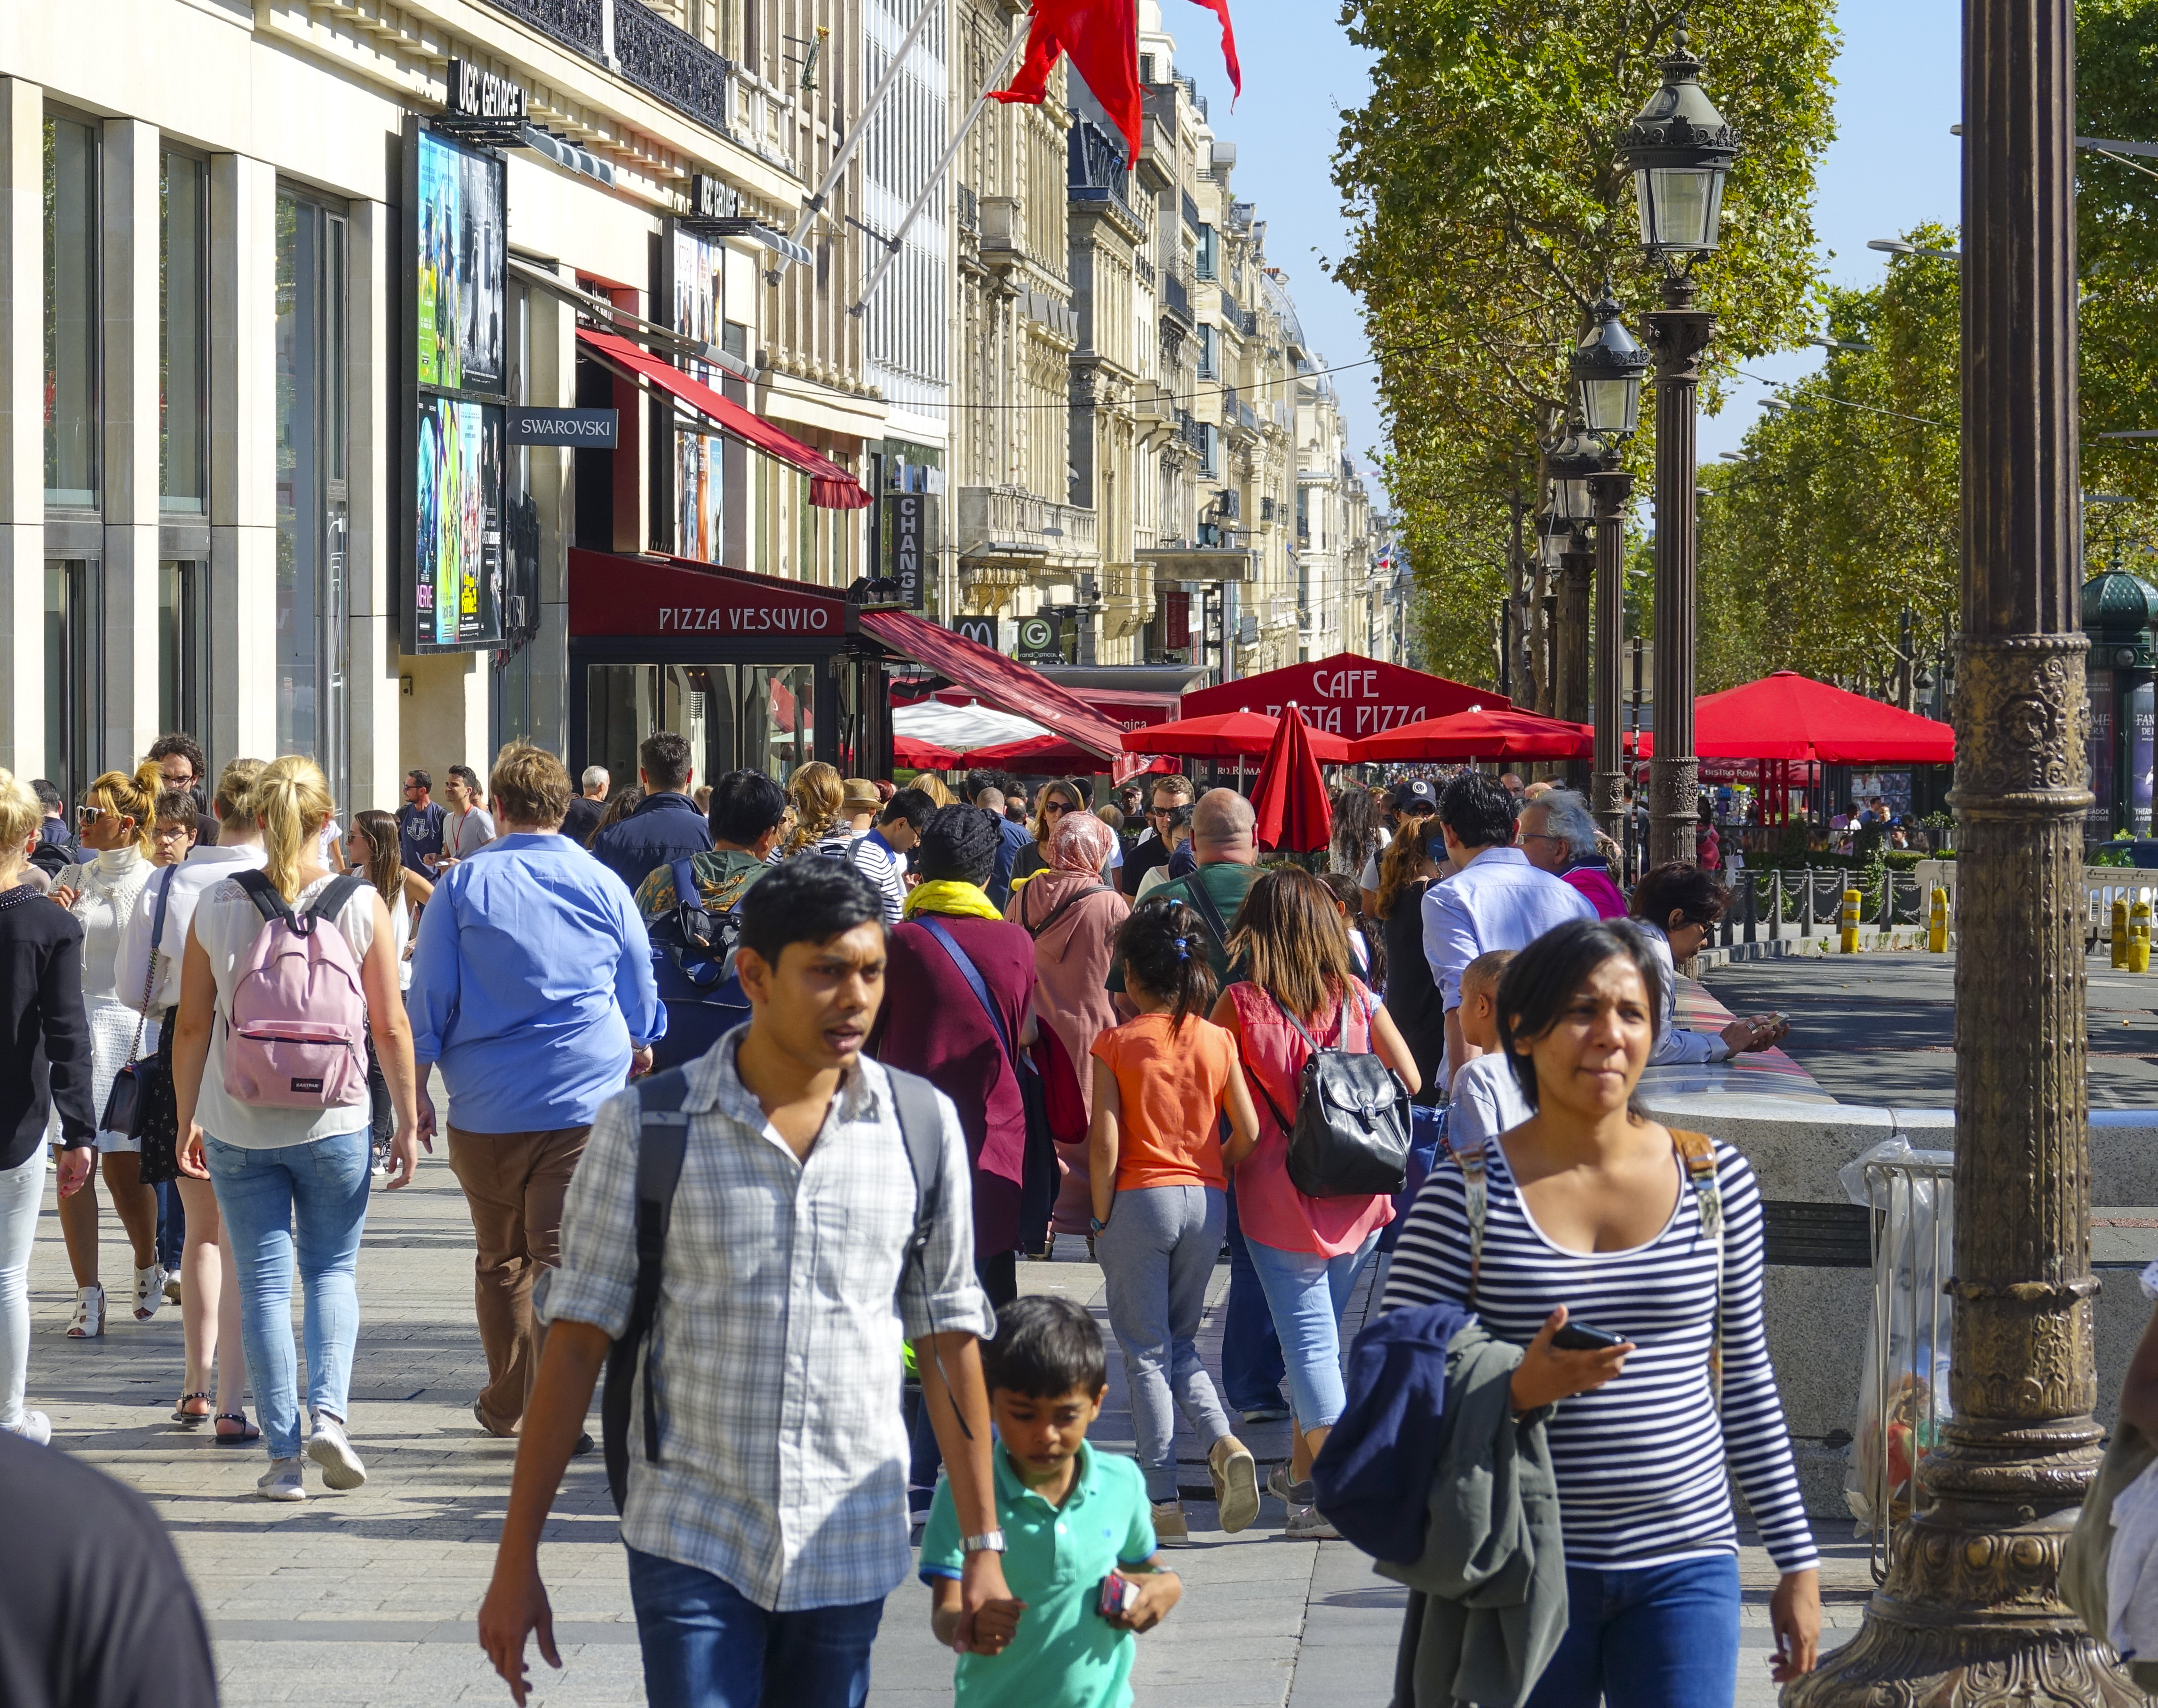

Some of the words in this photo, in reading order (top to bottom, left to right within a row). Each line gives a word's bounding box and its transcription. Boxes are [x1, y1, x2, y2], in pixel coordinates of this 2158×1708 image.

[459, 59, 479, 116] UGC
[482, 72, 518, 126] GEORGE
[521, 88, 528, 116] V
[701, 174, 713, 216] UGC
[715, 181, 736, 217] GEORGE
[737, 192, 742, 217] V
[521, 419, 610, 436] SWAROVSKI
[900, 498, 916, 607] CHANGE
[417, 585, 433, 608] NERVE
[660, 608, 720, 630] PIZZA
[728, 608, 828, 630] VESUVIO
[1027, 624, 1046, 644] G
[1313, 670, 1379, 698] CAFE
[1266, 705, 1341, 733] PSTA
[1356, 706, 1426, 733] PIZZA
